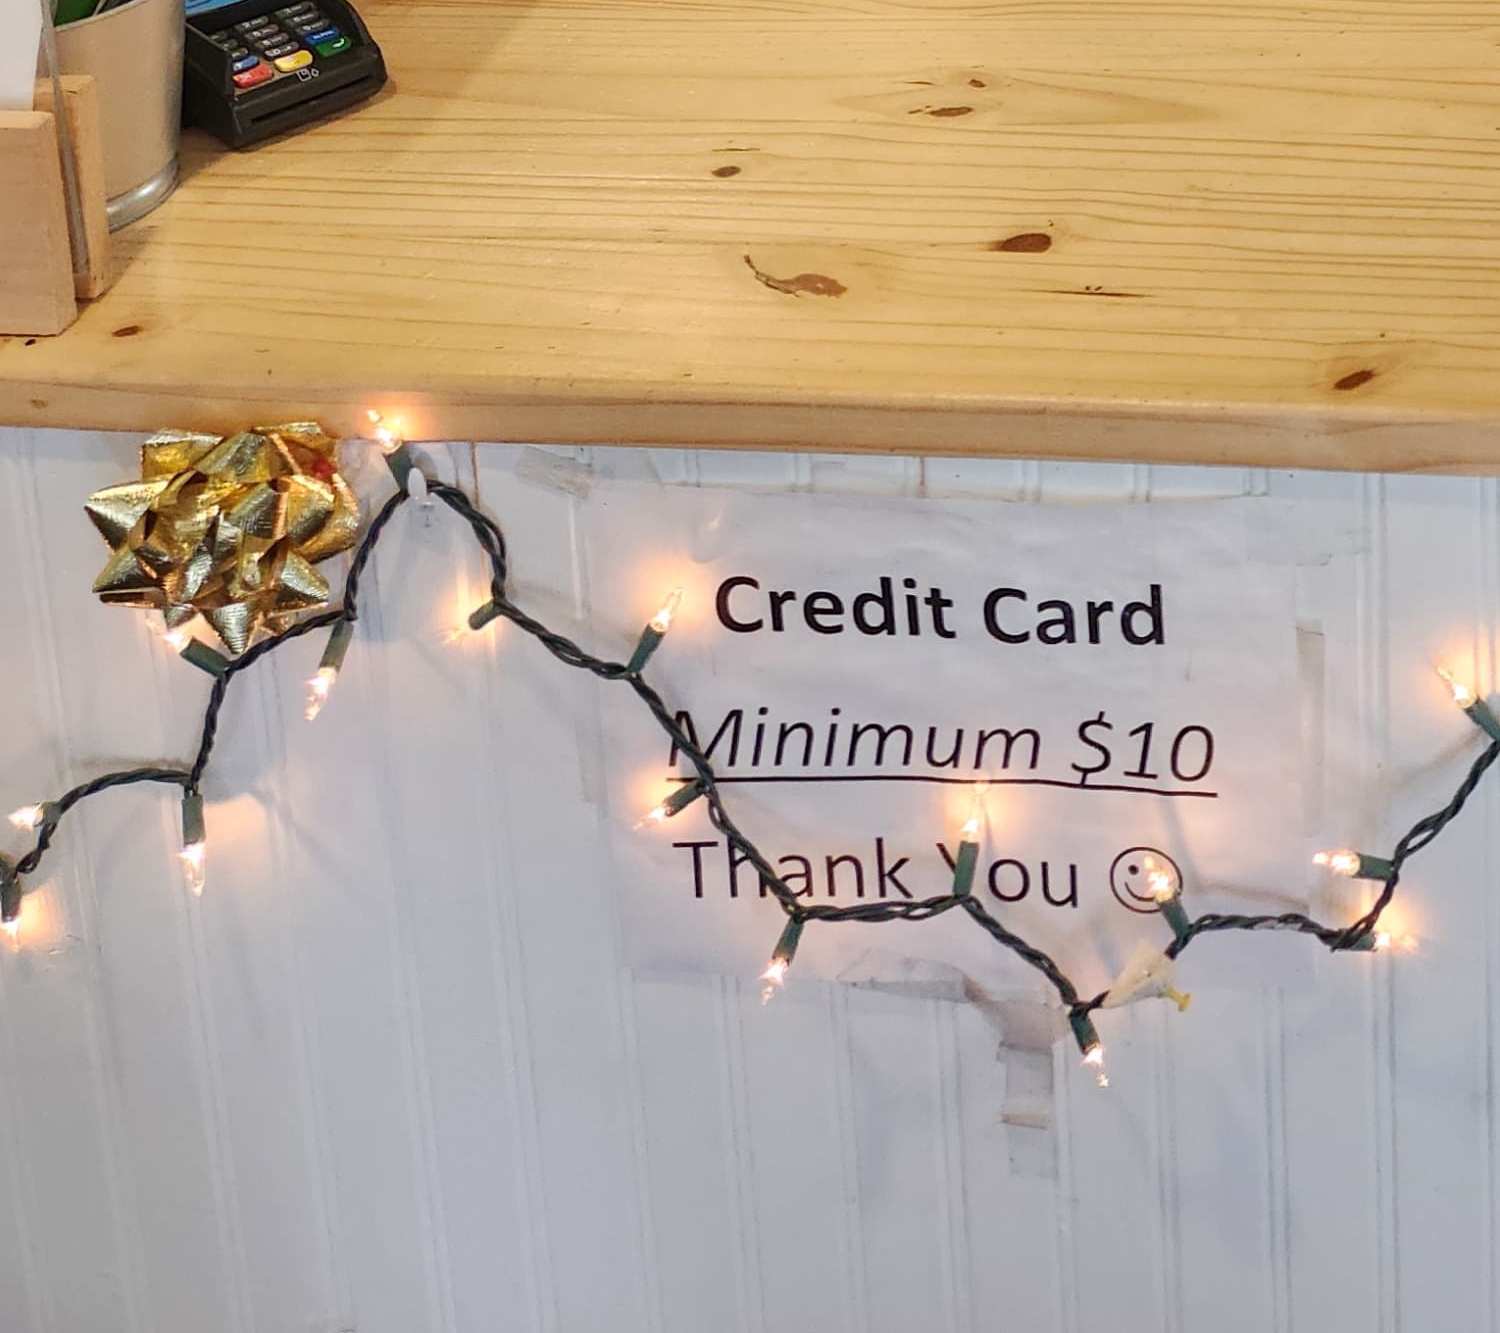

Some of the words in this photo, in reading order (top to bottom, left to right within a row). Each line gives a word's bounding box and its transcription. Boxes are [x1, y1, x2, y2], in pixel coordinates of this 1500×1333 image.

[714, 575, 957, 640] Credit
[983, 583, 1166, 646] Card
[667, 706, 1041, 771] Minimum
[1070, 710, 1216, 786] $10
[672, 837, 914, 900] Thank
